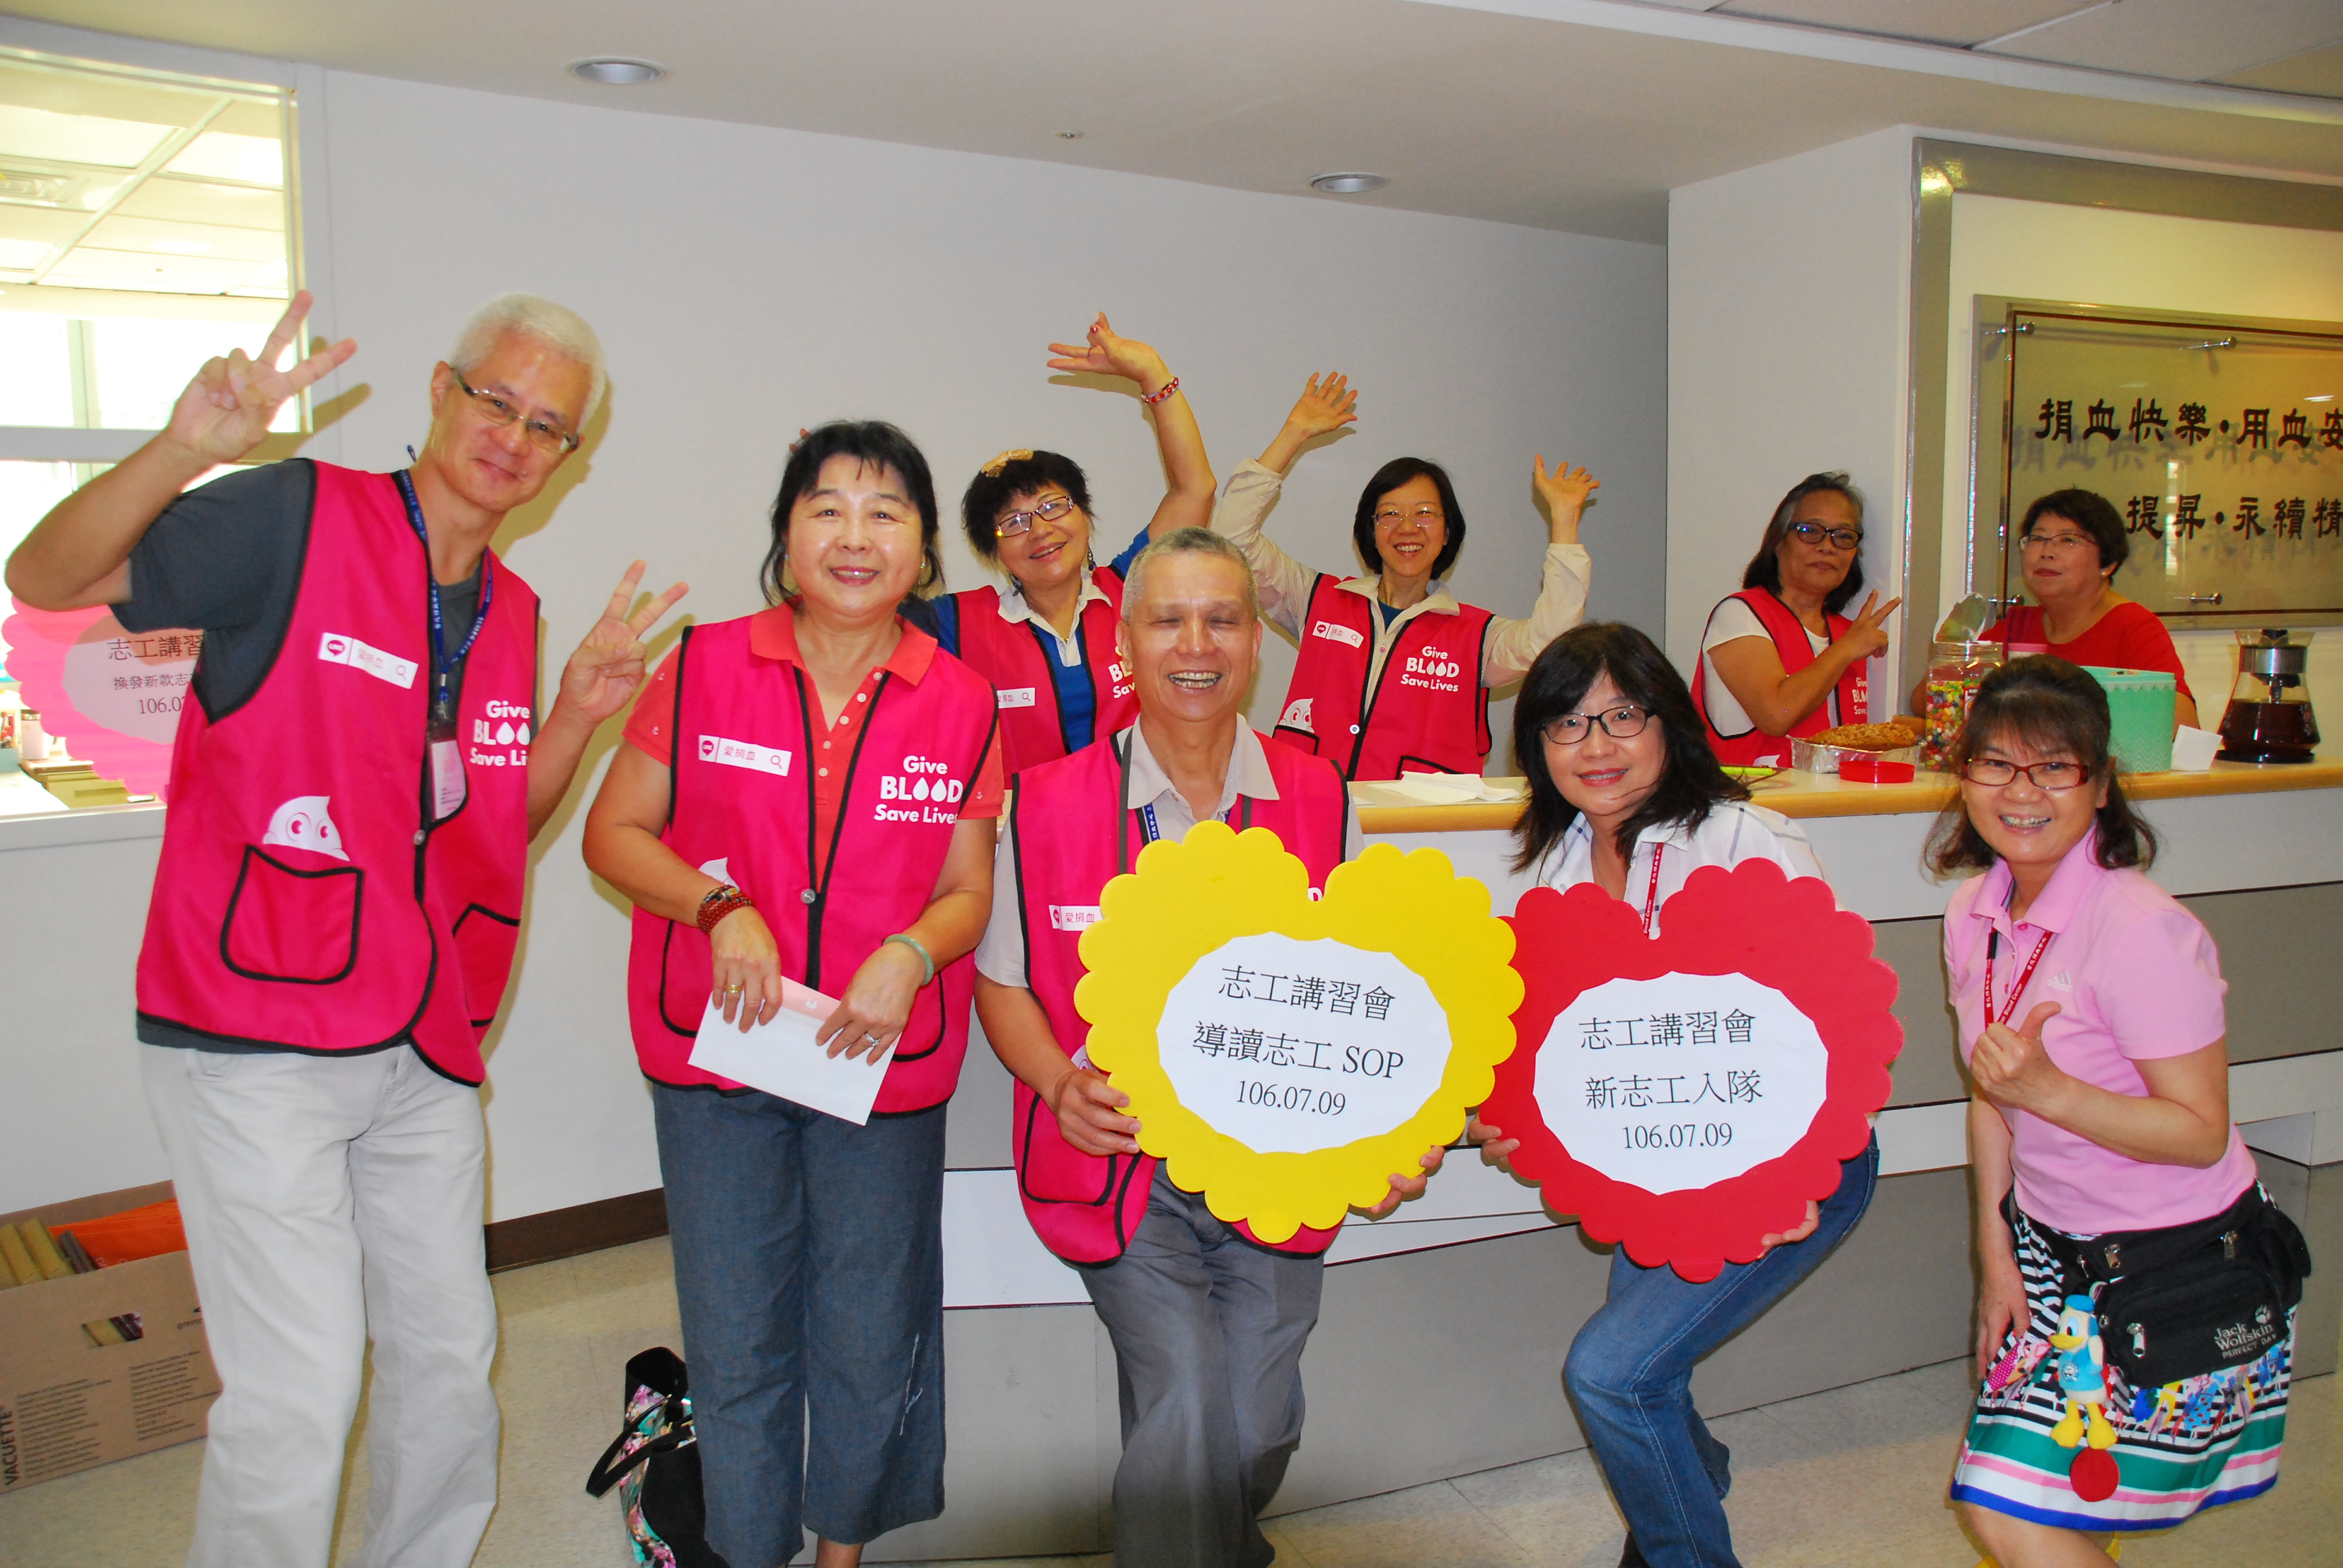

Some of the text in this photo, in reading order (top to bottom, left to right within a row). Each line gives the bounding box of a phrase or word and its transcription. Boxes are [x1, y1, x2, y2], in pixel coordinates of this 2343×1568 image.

[1421, 645, 1448, 659] Give
[1406, 657, 1460, 678] BLOOD
[114, 672, 193, 690] 換發新款志
[1400, 673, 1459, 692] Save Lives
[139, 696, 185, 714] 106.0
[486, 700, 531, 719] Give
[470, 747, 529, 766] Save Li
[903, 755, 948, 775] Give
[880, 776, 963, 803] BLOOD
[873, 803, 920, 822] Save
[1066, 912, 1095, 923] 愛捐血
[1217, 965, 1396, 1021] 志工講習會
[1578, 1008, 1756, 1050] 志工講習會
[1192, 1021, 1404, 1079] 導讀志工 SOP
[1236, 1080, 1346, 1116] 106.07.09
[1585, 1070, 1763, 1109] 新志工入隊
[1622, 1123, 1732, 1149] 106.07.09
[2214, 1322, 2247, 1340] Jack
[2215, 1324, 2275, 1350] Wolfskin
[2222, 1333, 2276, 1359] PERFECT DAY
